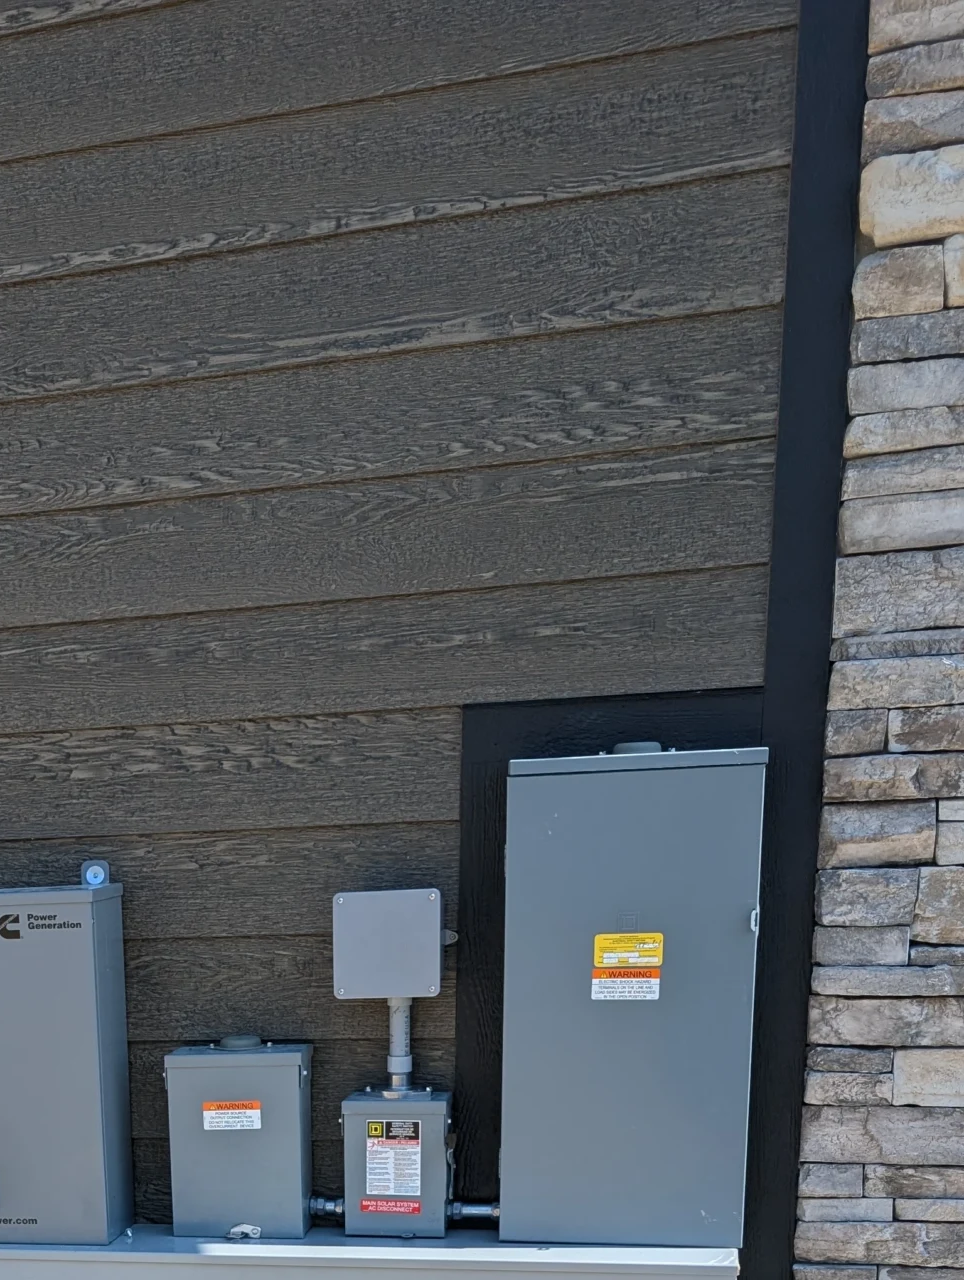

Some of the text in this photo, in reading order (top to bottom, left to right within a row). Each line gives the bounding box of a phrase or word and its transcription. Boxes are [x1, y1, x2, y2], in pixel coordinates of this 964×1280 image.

[27, 921, 82, 930] Generation
[608, 970, 652, 978] WARNING
[216, 1102, 253, 1110] WARNING
